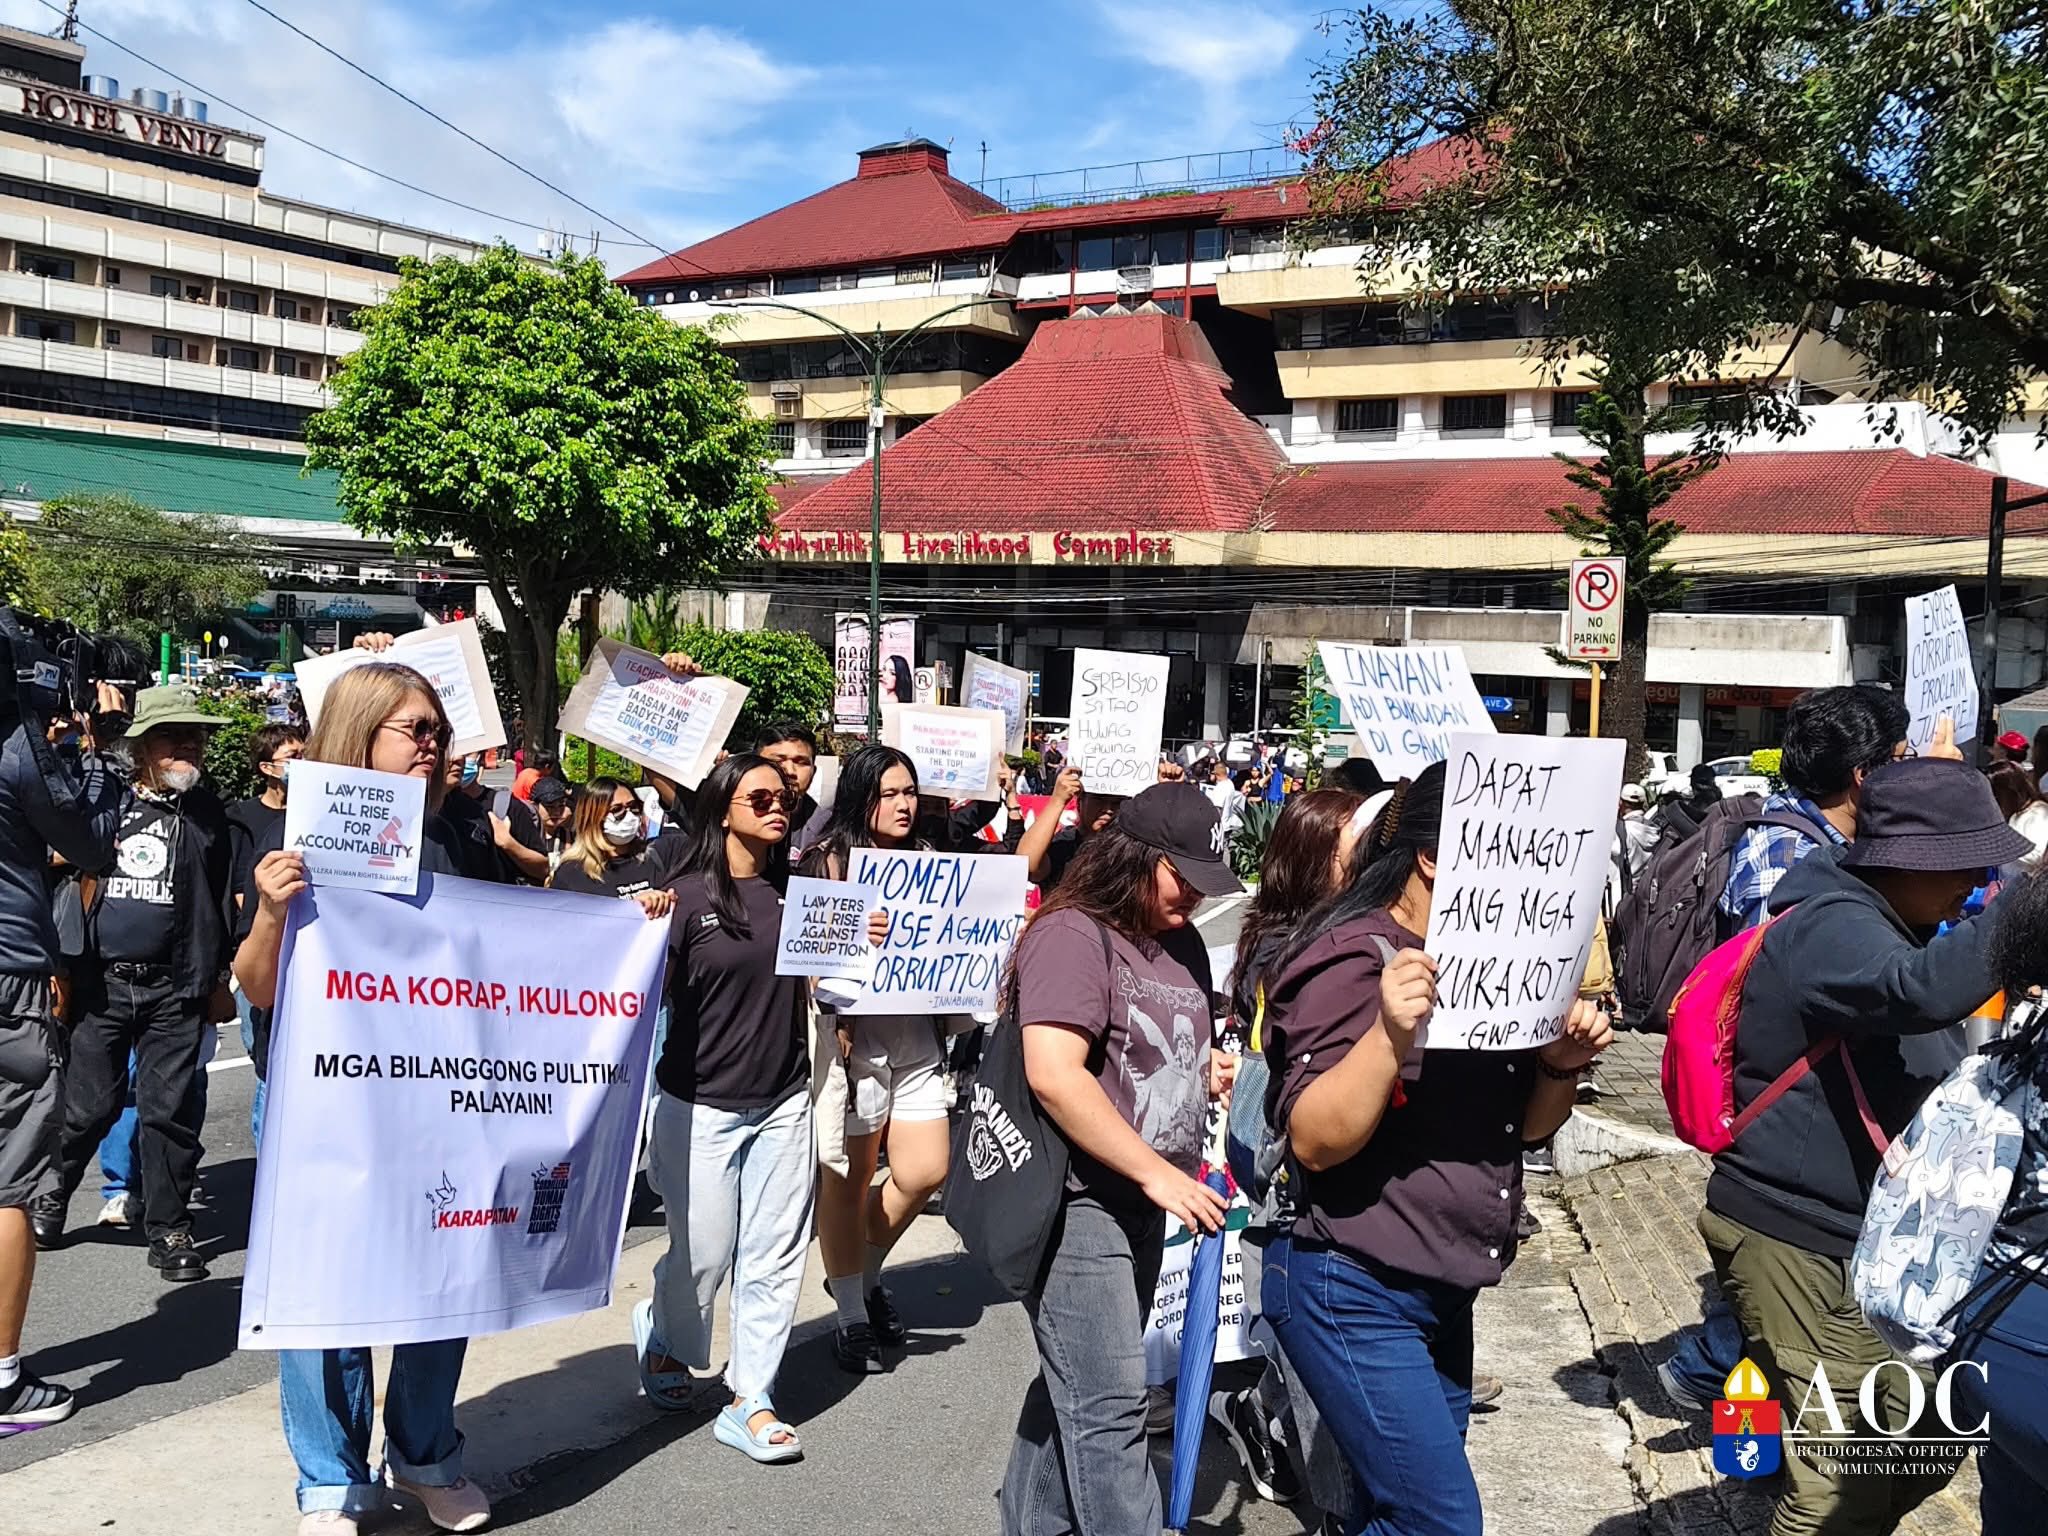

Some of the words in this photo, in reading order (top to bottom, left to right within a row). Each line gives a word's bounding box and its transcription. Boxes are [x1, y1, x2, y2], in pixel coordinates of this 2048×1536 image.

[21, 87, 125, 133] HOTEL
[134, 114, 226, 157] VENIZ
[758, 528, 876, 552] Maharlik
[1053, 527, 1173, 562] Complex
[1588, 617, 1603, 628] NO
[1922, 590, 1957, 636] EXPOSE
[1574, 633, 1616, 645] PARKING
[1912, 629, 1970, 679] CORRUPTION
[1081, 668, 1158, 697] SERBISYO
[1335, 646, 1453, 696] INAYAN!
[1920, 666, 1968, 713] PROCLAIM
[628, 688, 668, 714] TAASAN
[668, 706, 690, 723] ANG
[616, 711, 679, 747] EDUKASYON!
[664, 719, 679, 734] SA
[1078, 719, 1132, 740] HUWAG
[915, 745, 952, 757] STARTING
[954, 750, 977, 759] FROM
[1368, 728, 1393, 756] DI
[929, 757, 943, 767] THE
[325, 781, 395, 804] LAWYERS
[1450, 751, 1562, 814] DAPAT
[328, 801, 357, 817] ALL
[359, 804, 390, 821] RISE
[343, 820, 372, 837] FOR
[293, 833, 414, 859] ACCOUNTABILITY
[1451, 817, 1595, 876] MANAGOT
[357, 871, 380, 880] RIGHTS
[857, 855, 977, 909] WOMEN
[802, 894, 865, 912] LAWYERS
[1437, 886, 1504, 937] ANG
[1514, 886, 1576, 937] MGA
[802, 910, 828, 924] ALL
[831, 912, 861, 927] RISE
[936, 913, 1025, 948] AGAINST
[800, 925, 859, 942] AGAINST
[786, 939, 869, 957] CORRUPTION
[871, 952, 1001, 994] ORRUPTION
[326, 968, 401, 1004] MGA
[407, 976, 511, 1017] KORAP,
[518, 985, 645, 1019] IKULONG!
[314, 1053, 383, 1079] MGA
[390, 1056, 537, 1083] BILANGGONG
[450, 1089, 553, 1115] PALAYAIN!
[438, 1206, 519, 1228] KARAPATAN
